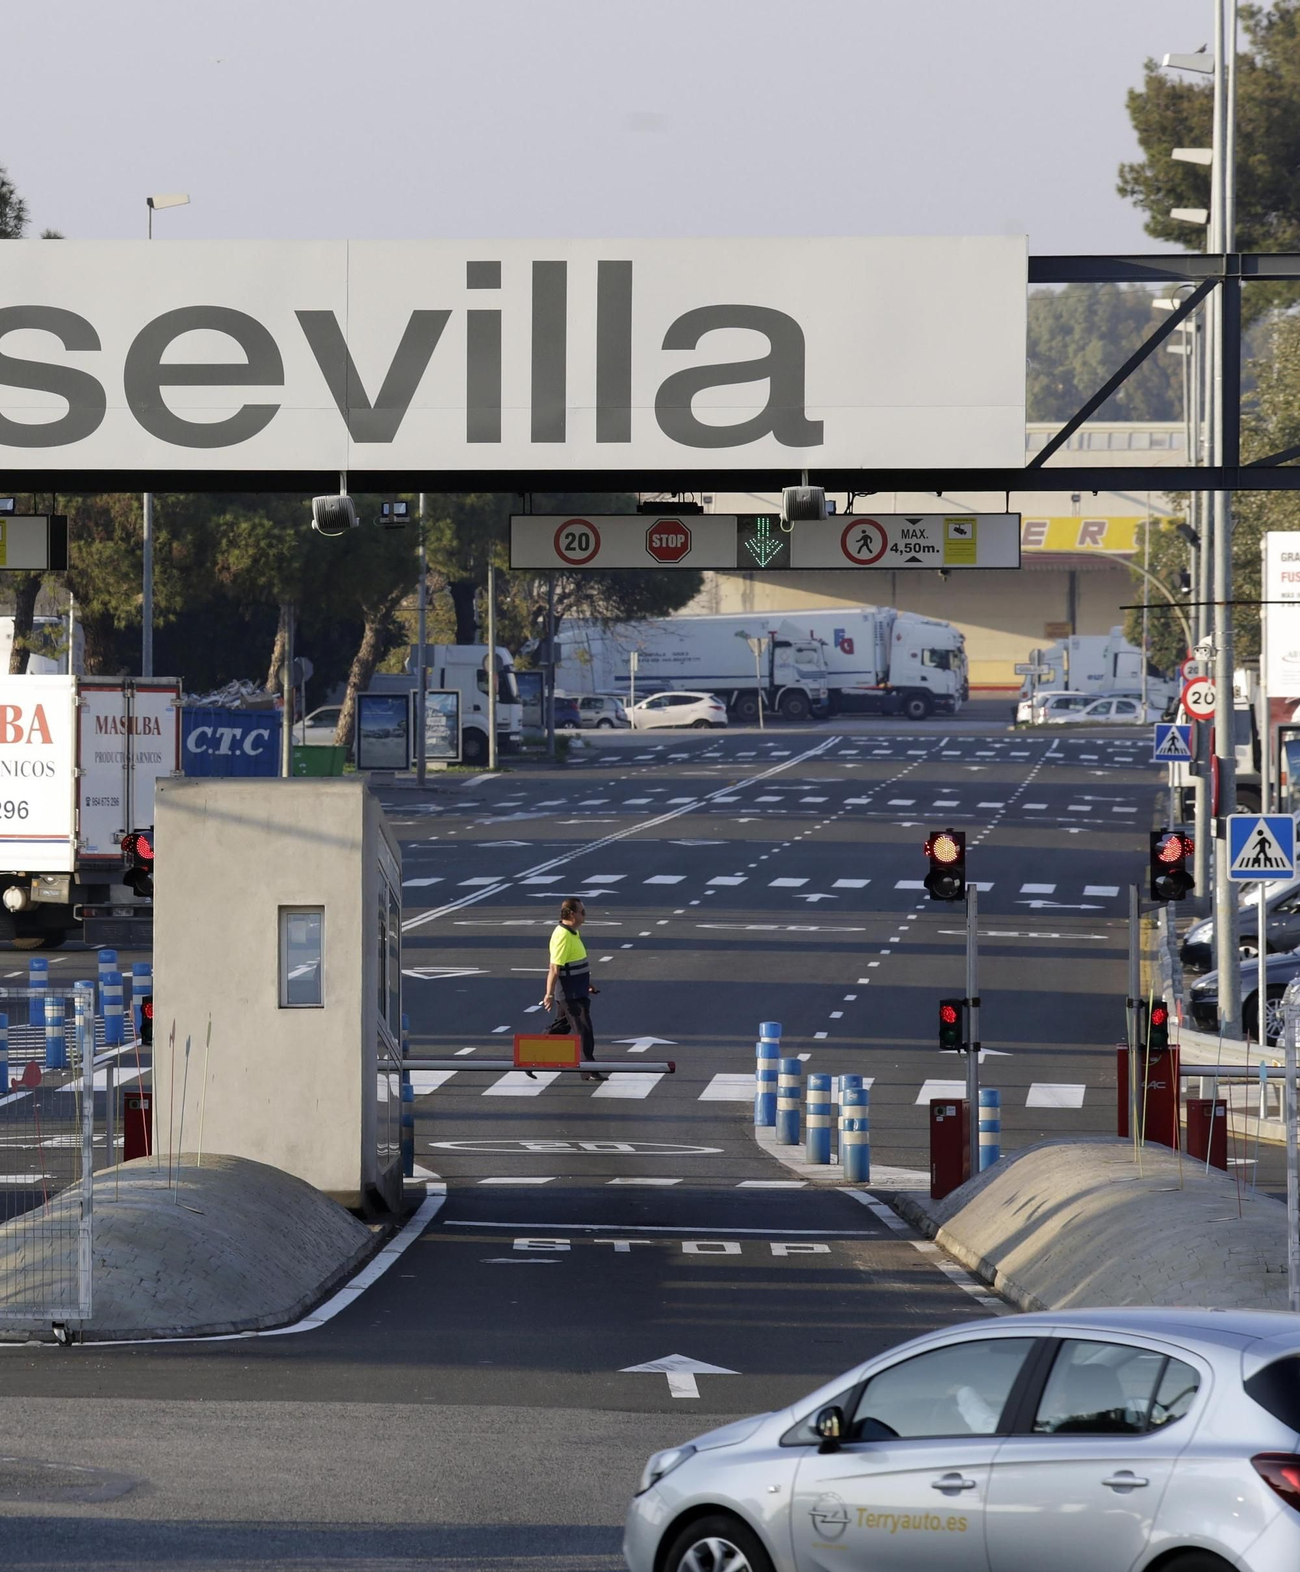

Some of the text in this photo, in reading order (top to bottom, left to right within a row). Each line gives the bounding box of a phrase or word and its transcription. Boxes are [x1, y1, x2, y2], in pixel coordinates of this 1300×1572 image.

[652, 534, 685, 548] STOP
[901, 528, 929, 540] MAX.
[564, 532, 590, 551] 20
[890, 542, 940, 554] 4,50m.
[1192, 691, 1215, 705] 20
[512, 1237, 832, 1256] STOP
[856, 1508, 968, 1534] Terryauto.es
